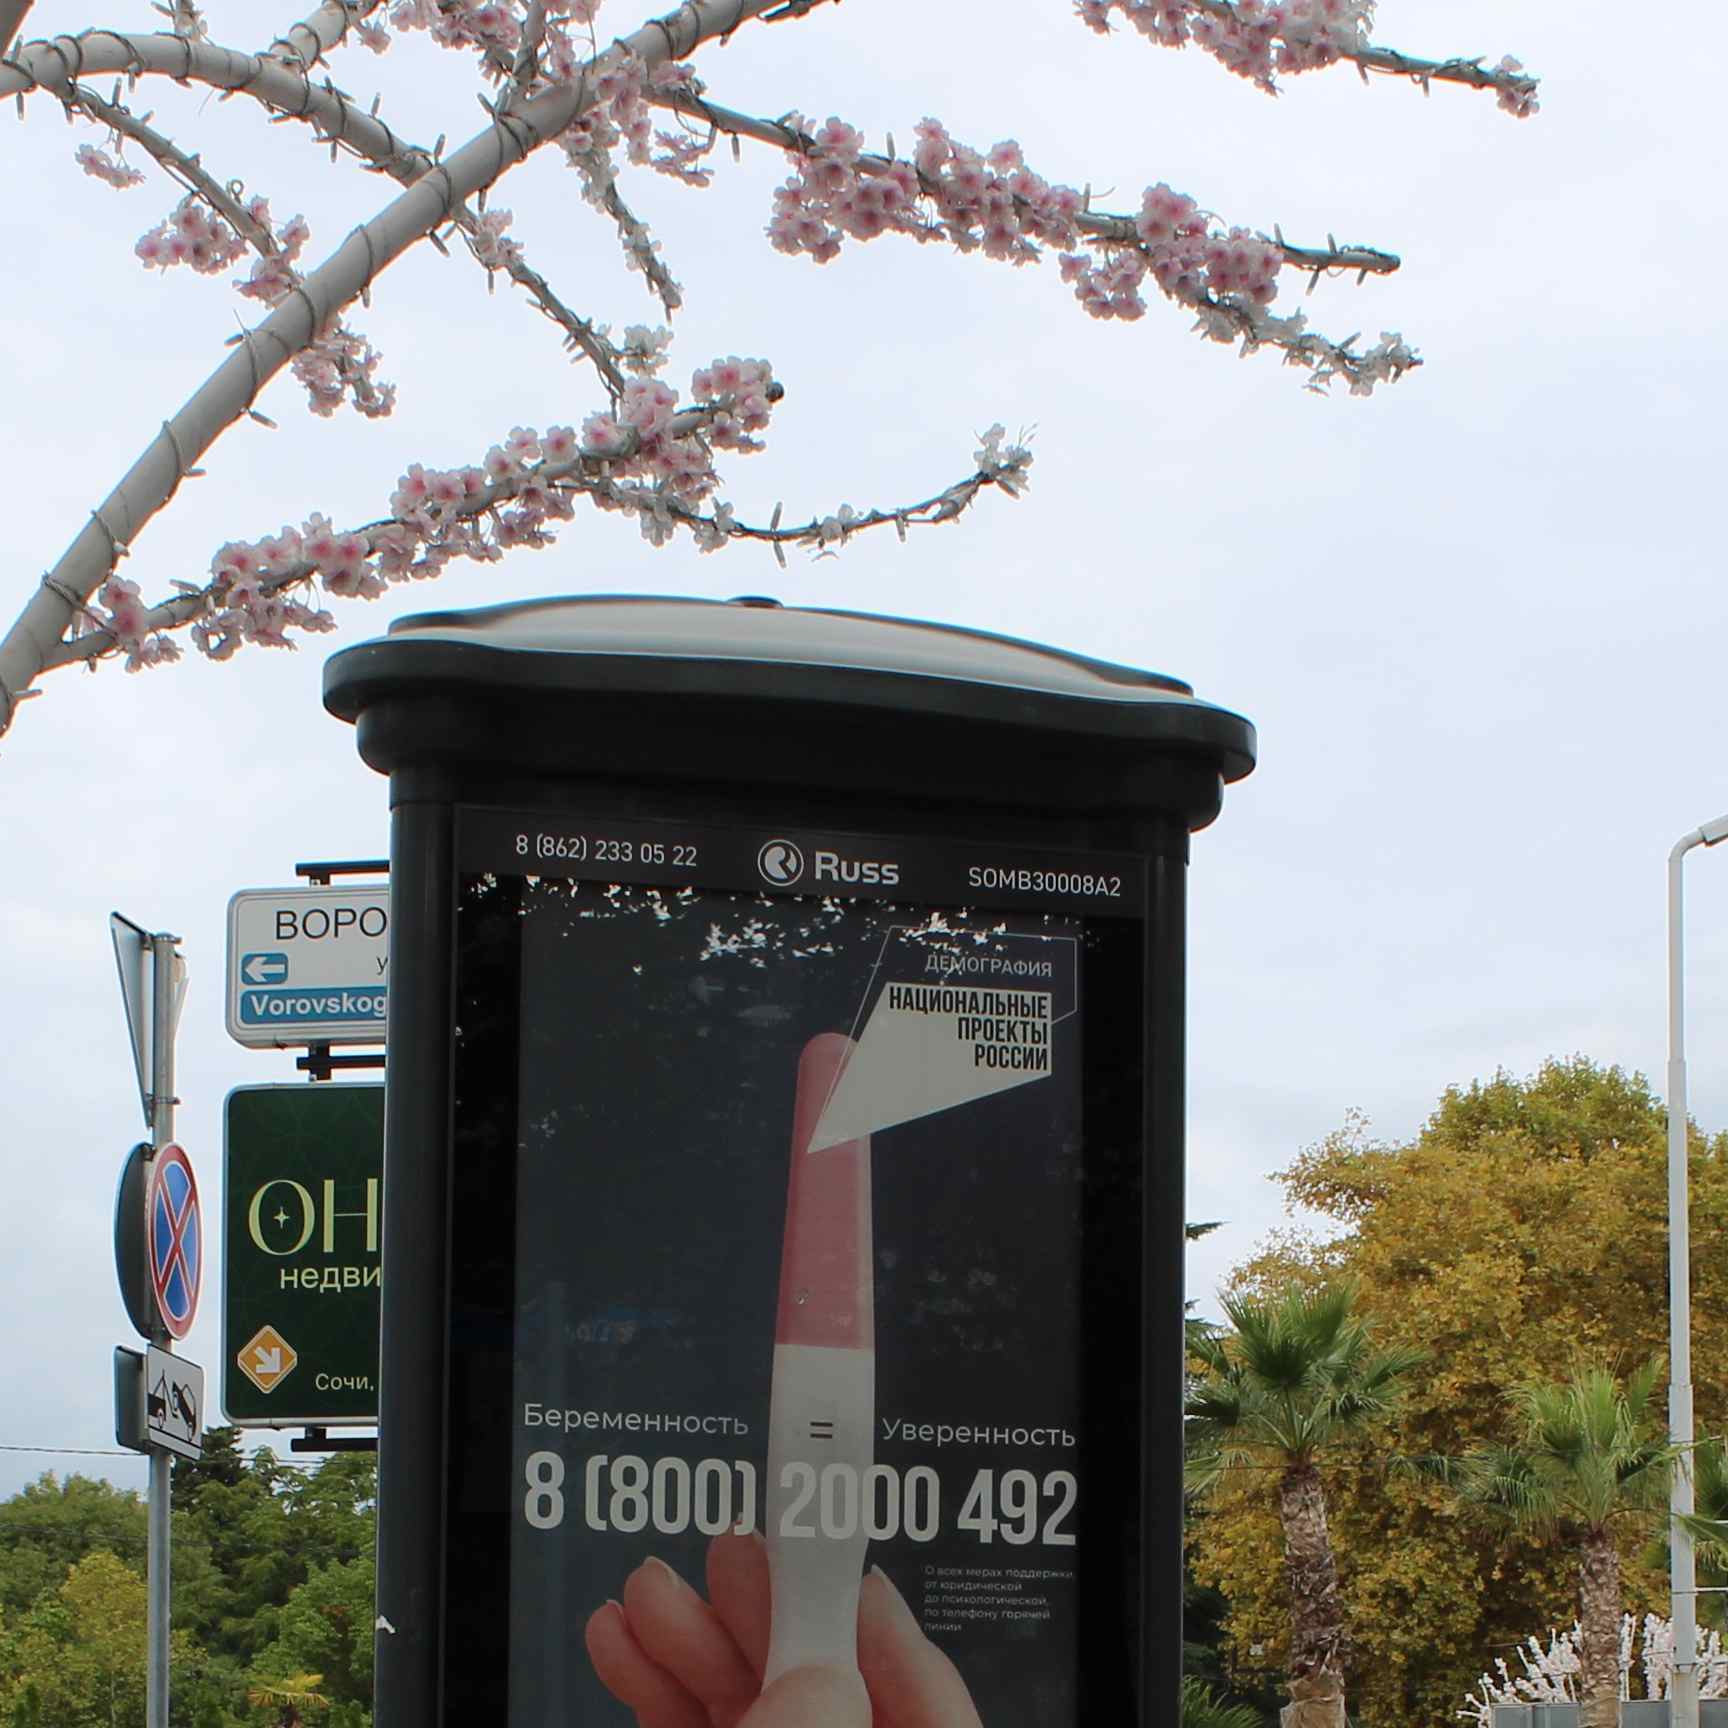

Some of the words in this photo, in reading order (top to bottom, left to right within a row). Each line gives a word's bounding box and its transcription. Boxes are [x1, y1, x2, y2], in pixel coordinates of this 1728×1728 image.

[515, 833, 528, 855] 8
[536, 833, 587, 860] (862)
[594, 840, 633, 862] 233
[640, 843, 665, 865] 05
[672, 845, 697, 867] 22
[814, 850, 900, 886] Russ
[968, 867, 1121, 897] SOMB30008A2
[276, 906, 388, 940] ВОРО
[924, 954, 1052, 977] ДЕМОГРАФИЯ
[889, 985, 1047, 1019] НАЦИОНАЛЬНЫЕ
[958, 1017, 1047, 1045] ПРОЕКТЫ
[974, 1043, 1047, 1071] РОССИИ
[280, 1266, 381, 1293] недви
[524, 1403, 749, 1435] Беременность
[881, 1417, 1076, 1448] Уверенность
[524, 1450, 565, 1530] 8
[585, 1455, 756, 1536] (800)
[779, 1461, 940, 1542] 2000
[957, 1468, 1078, 1546] 492
